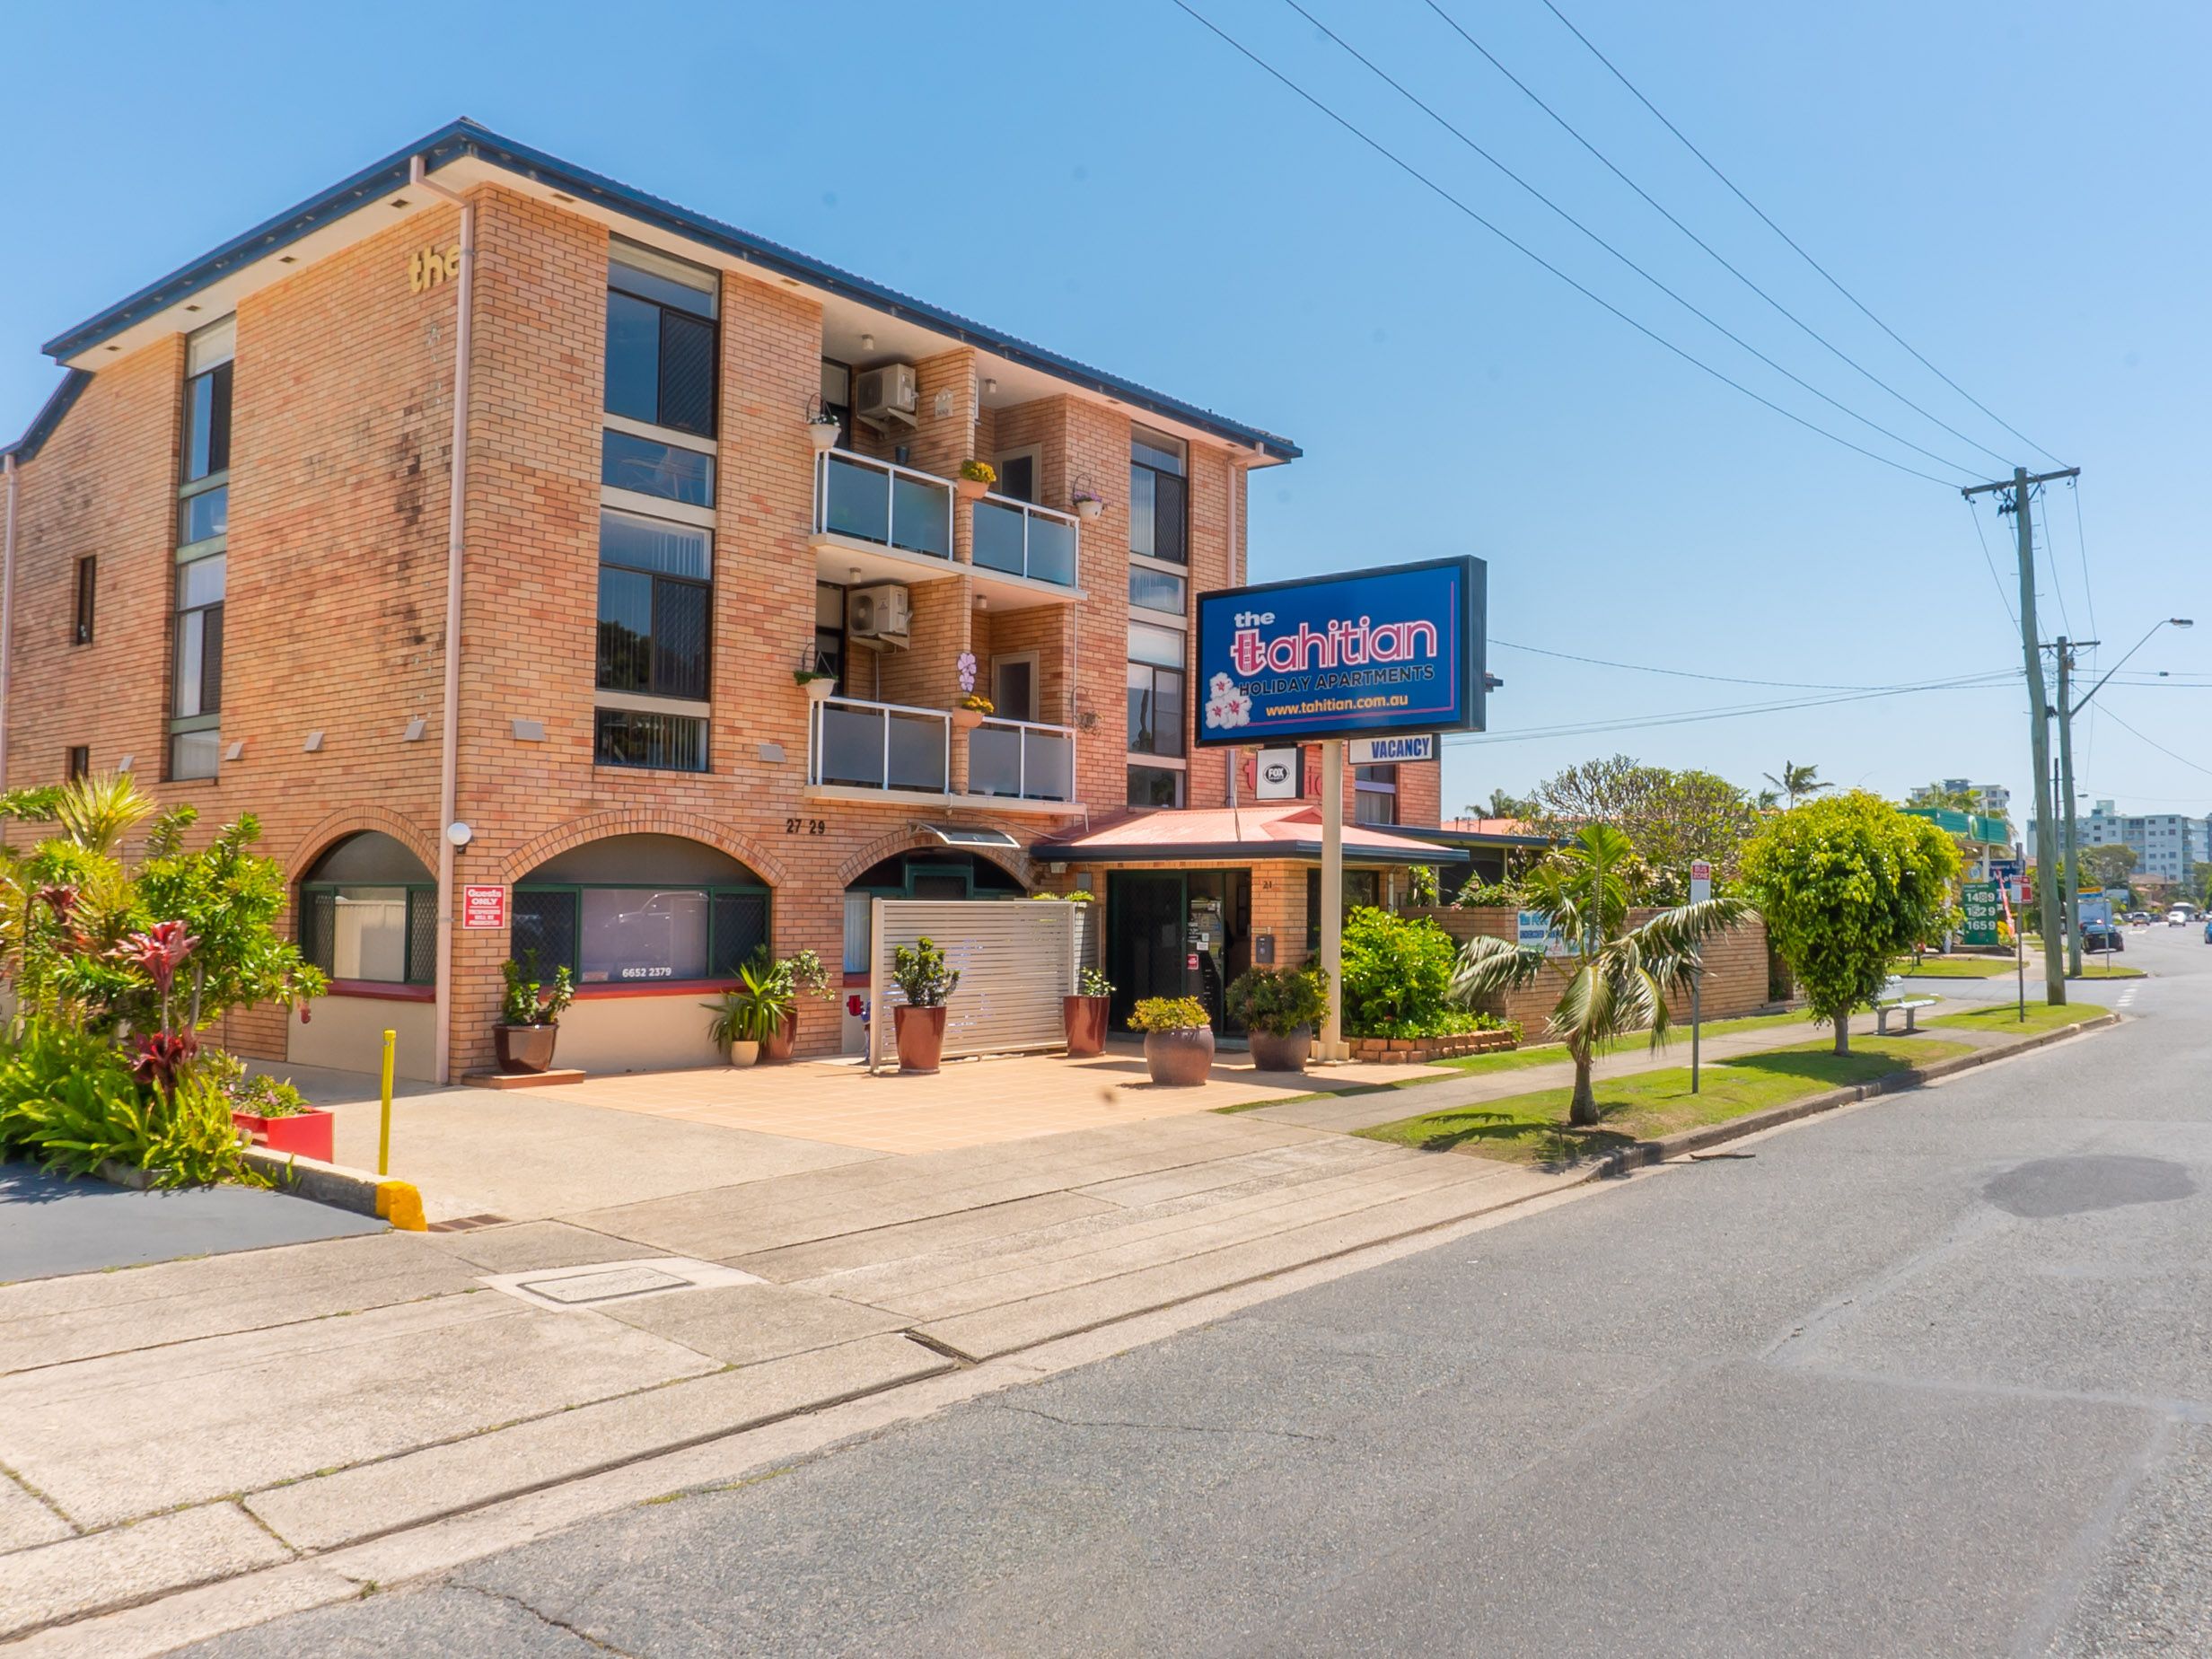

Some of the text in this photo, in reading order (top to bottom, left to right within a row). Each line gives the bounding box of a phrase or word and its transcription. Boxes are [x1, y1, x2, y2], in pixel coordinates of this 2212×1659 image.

[408, 243, 461, 293] the
[1233, 611, 1276, 628] the
[1230, 615, 1437, 677] tahitian
[1239, 664, 1435, 697] HOLIDAY APARTMENTS
[1265, 694, 1409, 717] www.tahitian.com.au
[1371, 737, 1430, 759] VACANCY
[1268, 768, 1285, 777] FOX
[786, 818, 825, 834] 27 29
[622, 967, 672, 978] 6652 2379
